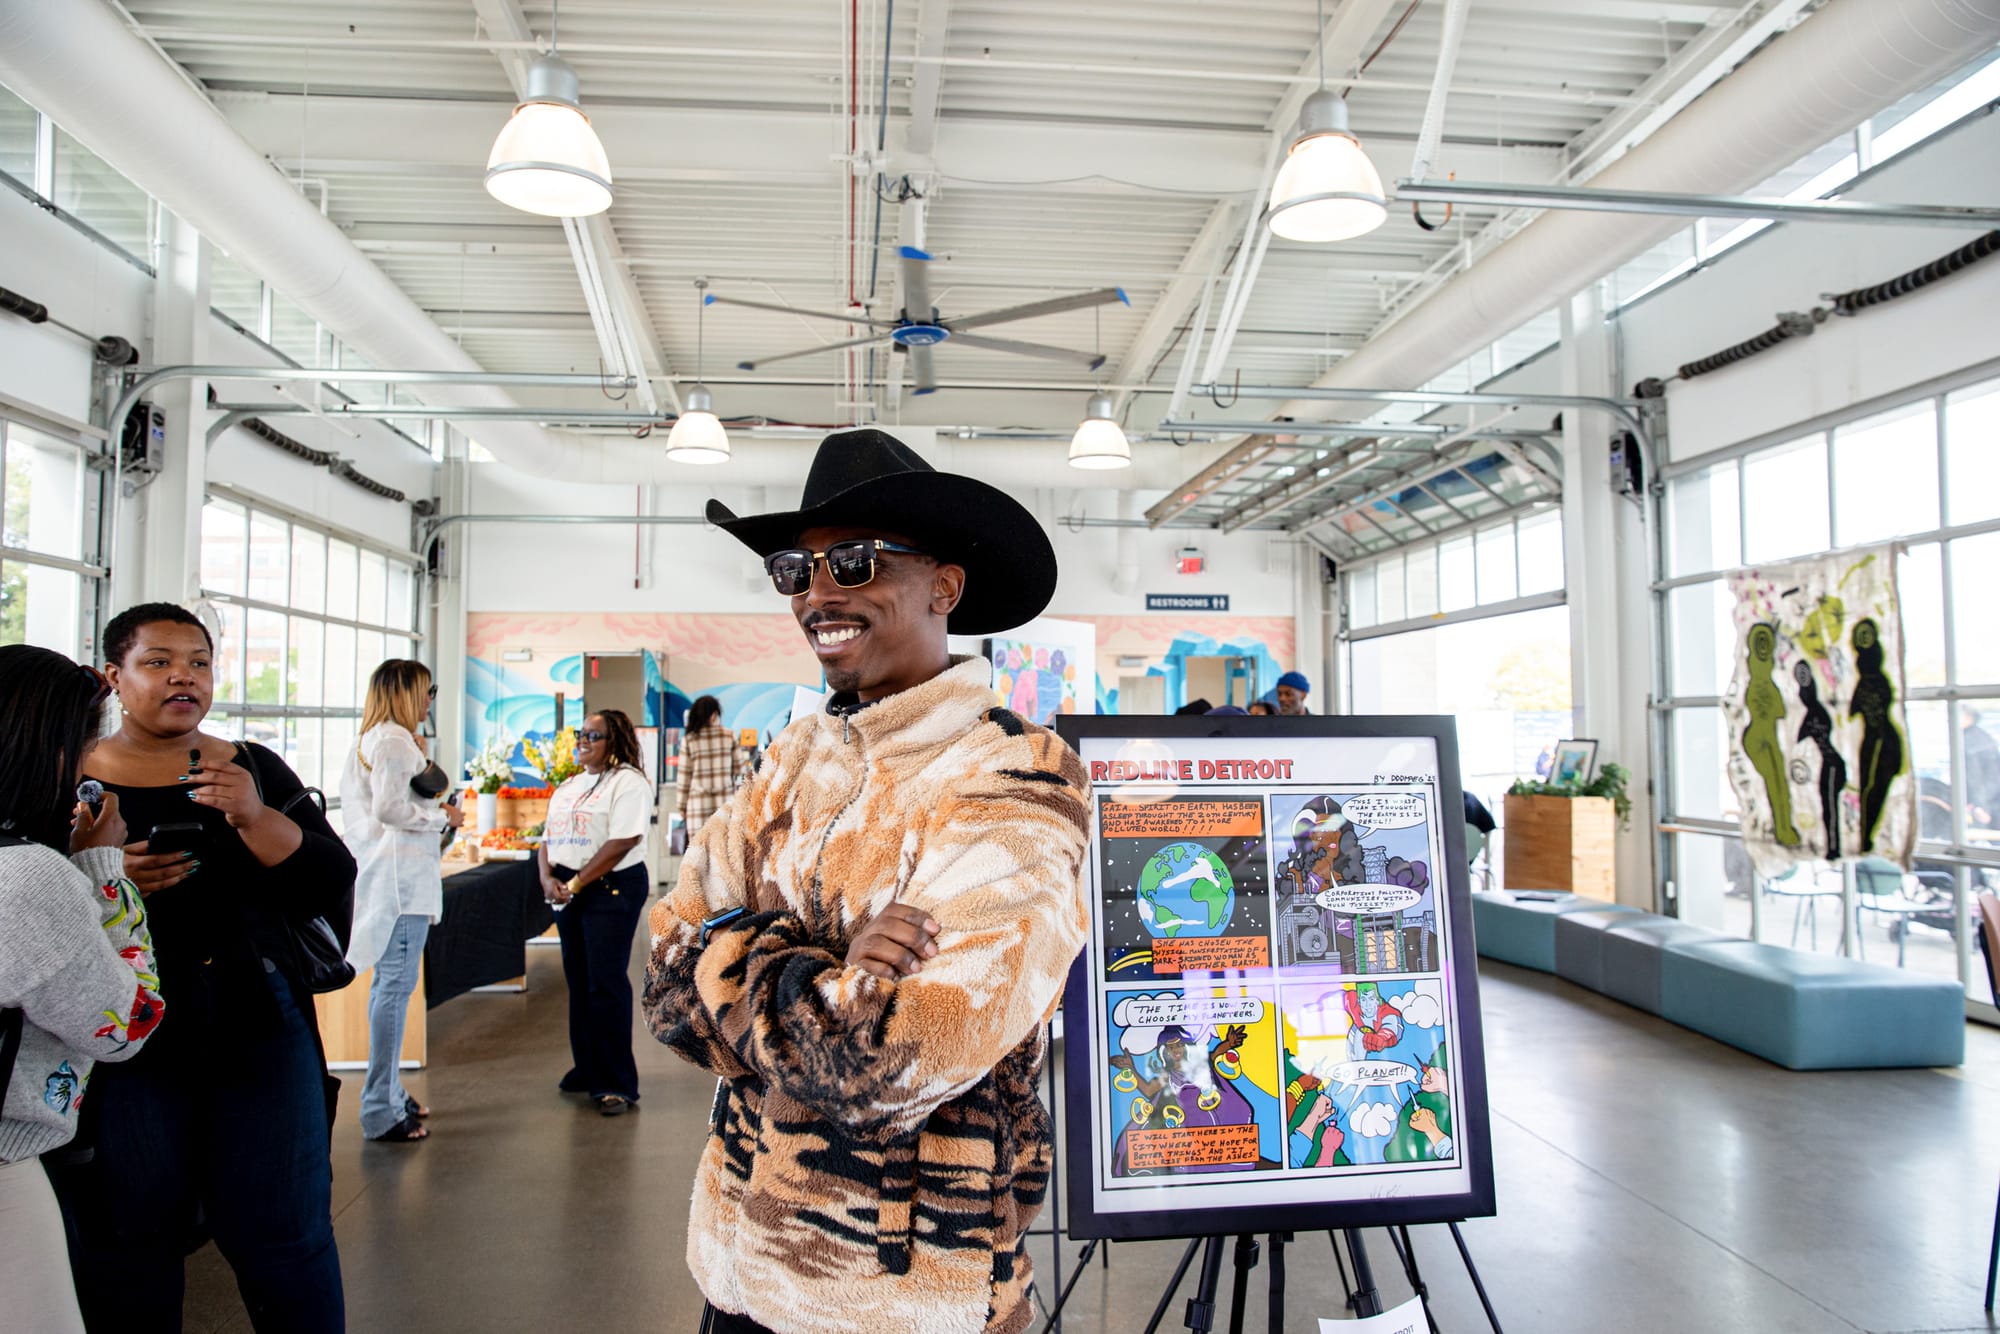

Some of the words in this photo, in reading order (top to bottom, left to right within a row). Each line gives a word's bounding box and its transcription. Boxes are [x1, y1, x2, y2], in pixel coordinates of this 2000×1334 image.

[1150, 598, 1209, 607] RESTROOMS
[1091, 760, 1193, 781] REDLINE
[1198, 759, 1293, 779] DETROIT
[1373, 774, 1385, 783] BY
[1139, 803, 1171, 811] SPIRIT
[1222, 811, 1257, 820] CENTURY
[1156, 940, 1176, 948] SHE
[1179, 963, 1227, 971] MOTHER
[1134, 1005, 1161, 1013] THE
[1168, 1003, 1198, 1012] TIME
[1138, 1014, 1178, 1023] CHOOSE
[1333, 1068, 1351, 1078] GO
[1358, 1065, 1408, 1077] PLANET!!
[1129, 1133, 1140, 1141] I
[1172, 1131, 1195, 1139] START
[1132, 1143, 1156, 1151] CITY
[1133, 1151, 1164, 1160] BETTER
